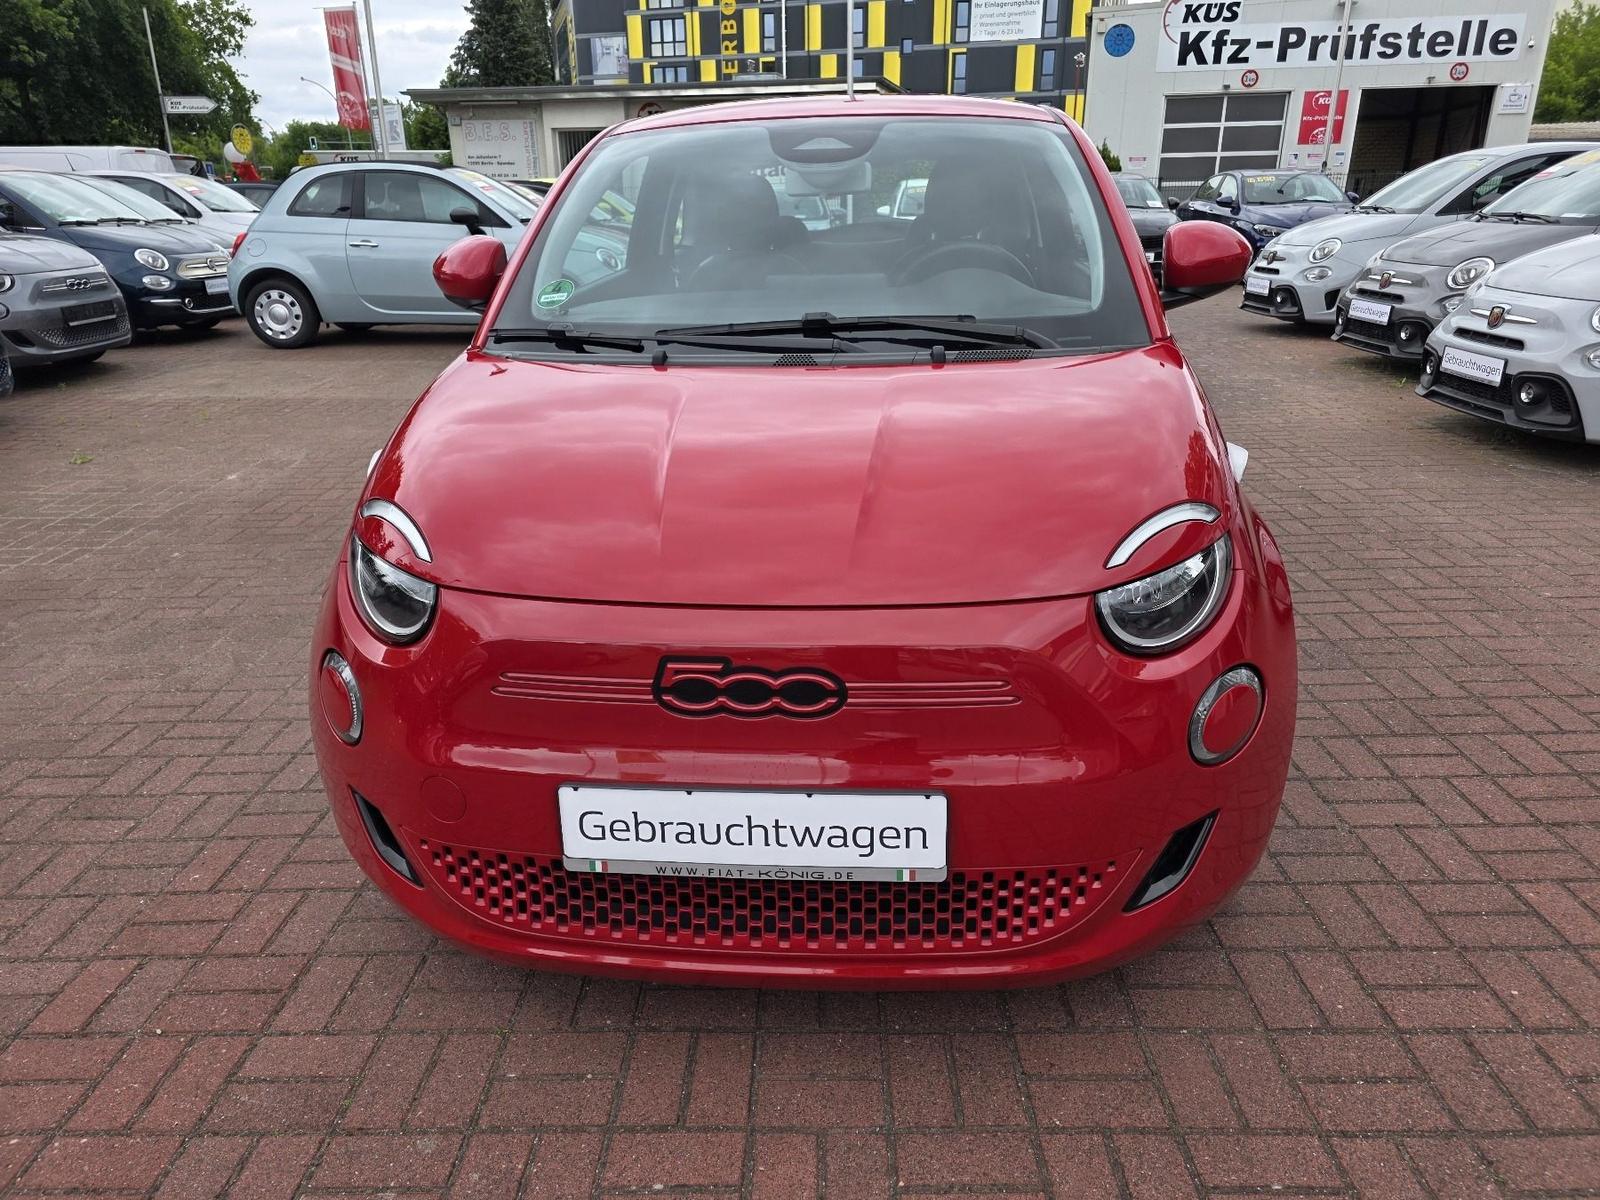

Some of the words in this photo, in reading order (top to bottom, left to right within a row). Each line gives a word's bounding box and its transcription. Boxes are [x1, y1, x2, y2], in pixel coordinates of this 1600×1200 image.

[985, 0, 1040, 8] Einlagerungshaus
[1182, 1, 1241, 24] KÜS
[1177, 20, 1517, 66] Kfz-Prüfstelle
[66, 278, 91, 290] 500
[1444, 352, 1501, 377] Gebrauchtwagen
[655, 657, 844, 716] 500
[578, 810, 929, 858] Gebrauchtwagen
[655, 865, 854, 880] WWW.FIAT-KÖNIG.DE
